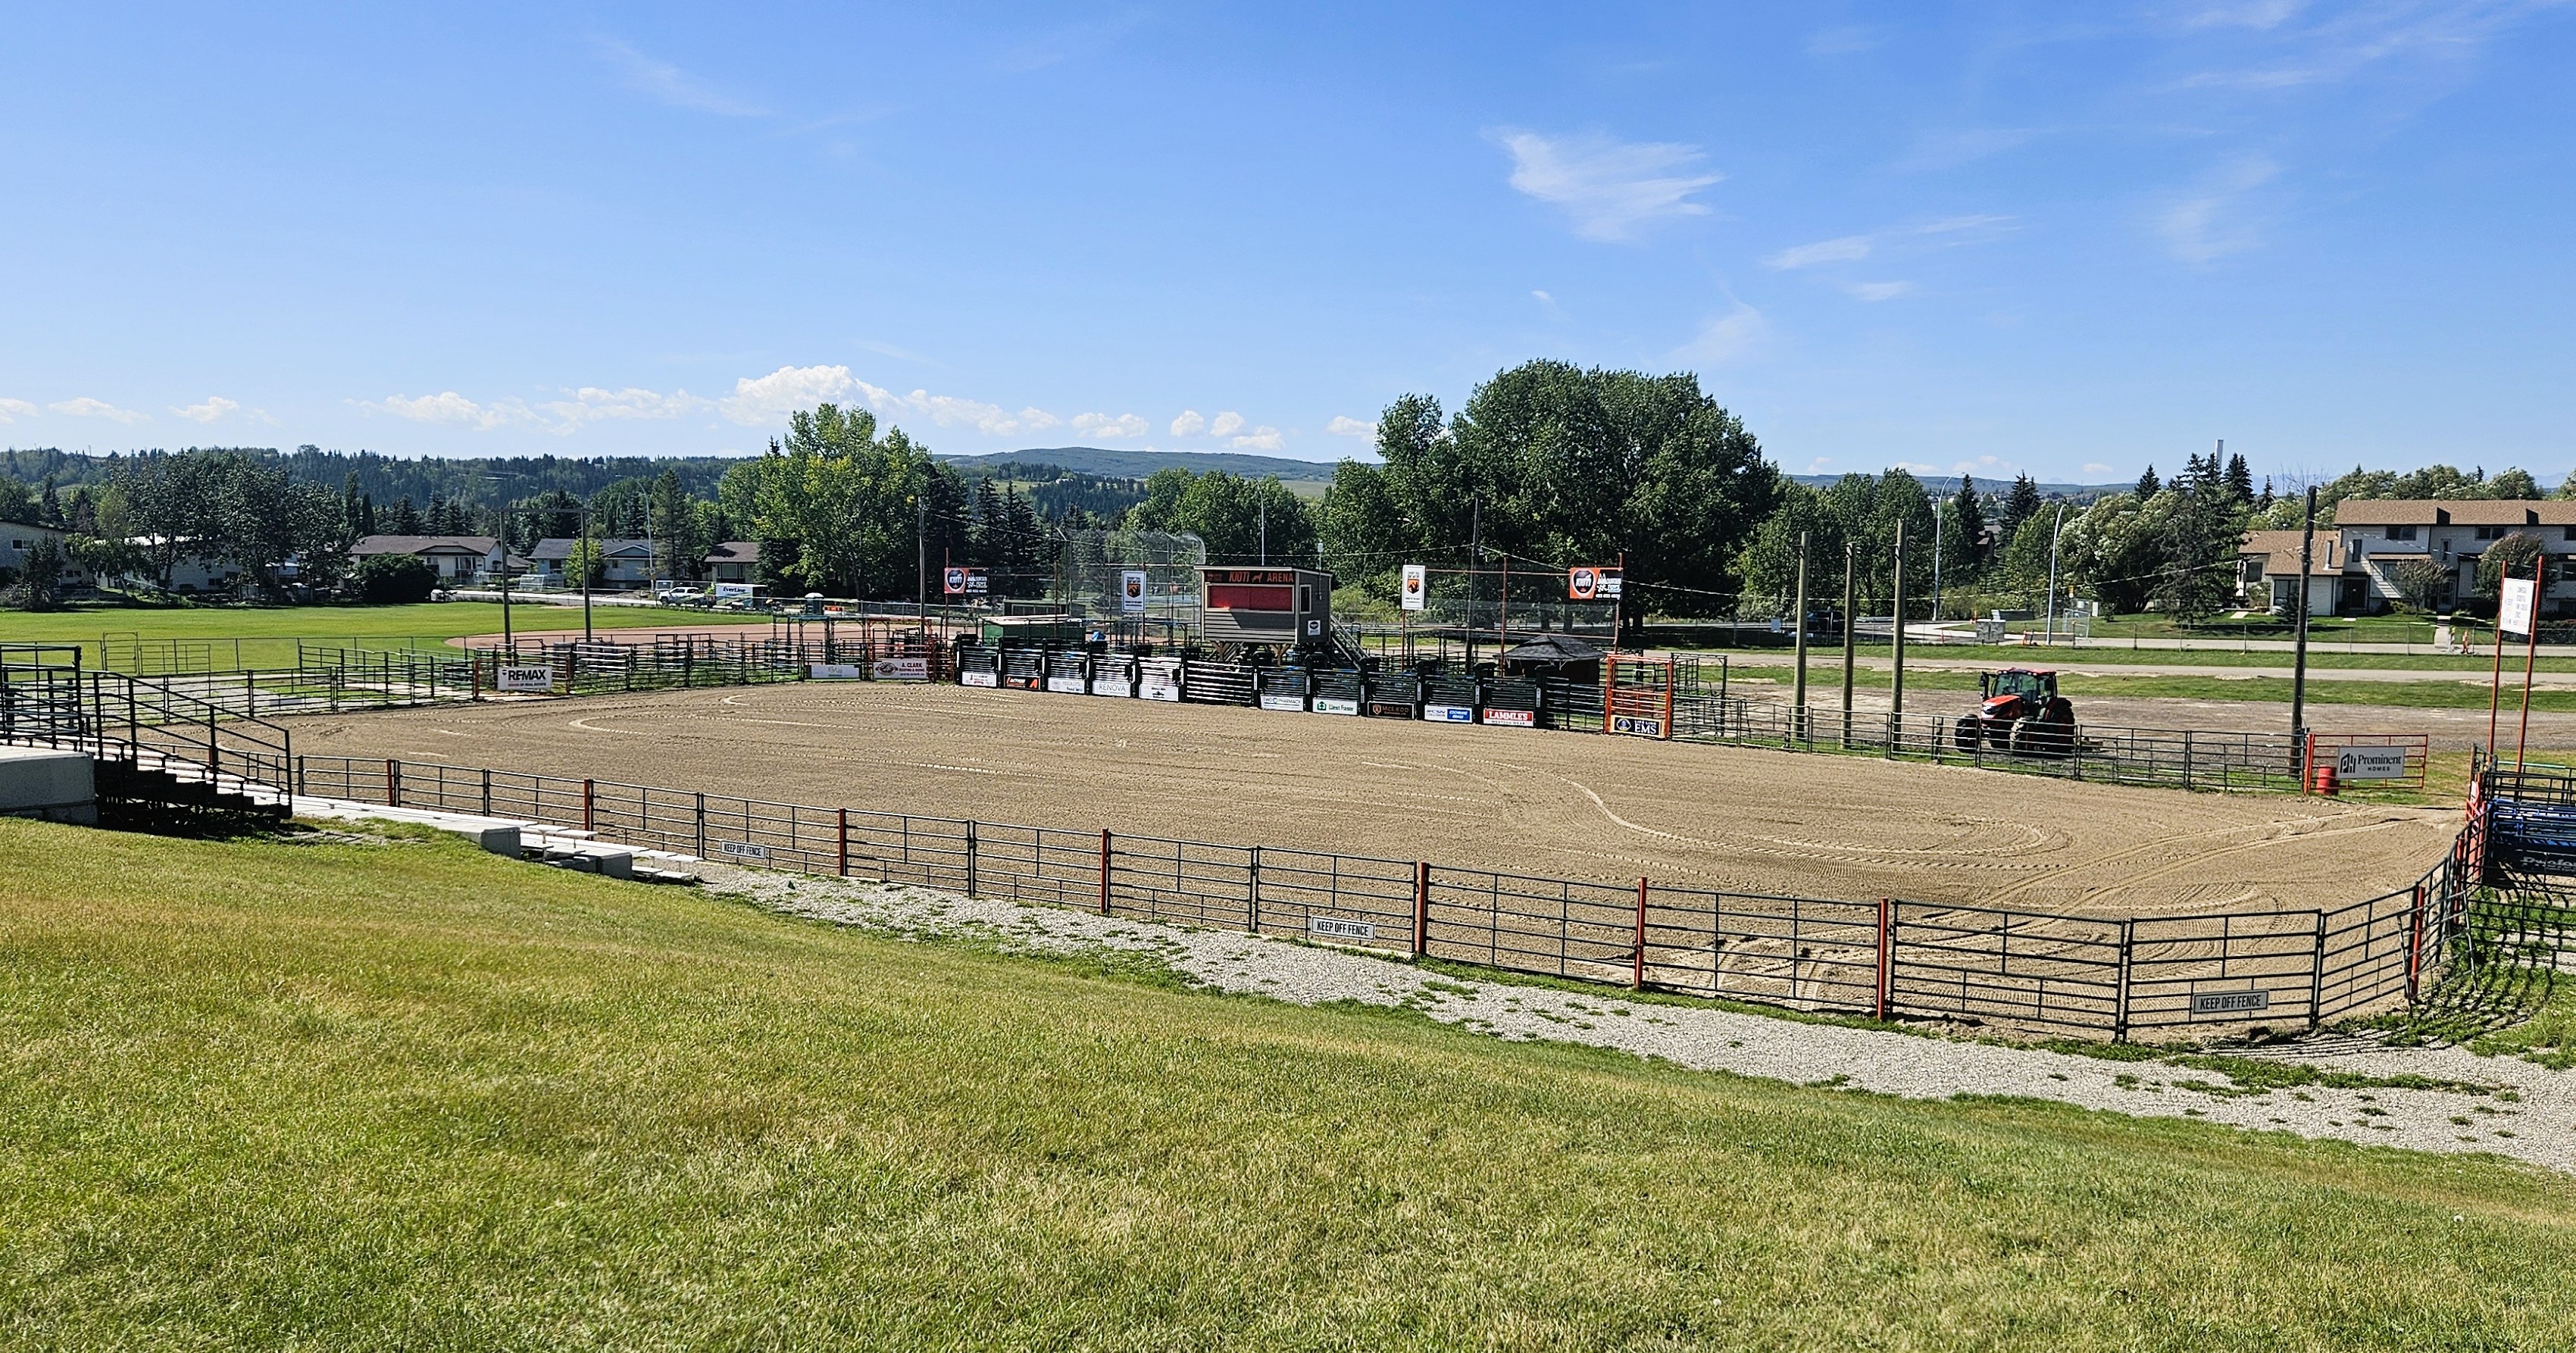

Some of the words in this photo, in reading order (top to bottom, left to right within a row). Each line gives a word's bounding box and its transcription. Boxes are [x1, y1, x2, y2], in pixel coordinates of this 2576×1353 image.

[1229, 571, 1250, 583] KIOTI
[1267, 572, 1294, 583] ARENA
[1099, 683, 1126, 692] RENOVA
[1634, 723, 1657, 735] EMS
[2358, 753, 2401, 765] Prominent
[724, 843, 736, 853] KEEP
[736, 845, 746, 855] OFF
[746, 846, 761, 857] FENCE
[1317, 920, 1333, 932] KEEP
[1334, 922, 1347, 933] OFF
[1348, 924, 1369, 936] FENCE
[2199, 996, 2220, 1010] KEEP
[2221, 995, 2236, 1009] OFF
[2237, 994, 2262, 1008] FENCE
